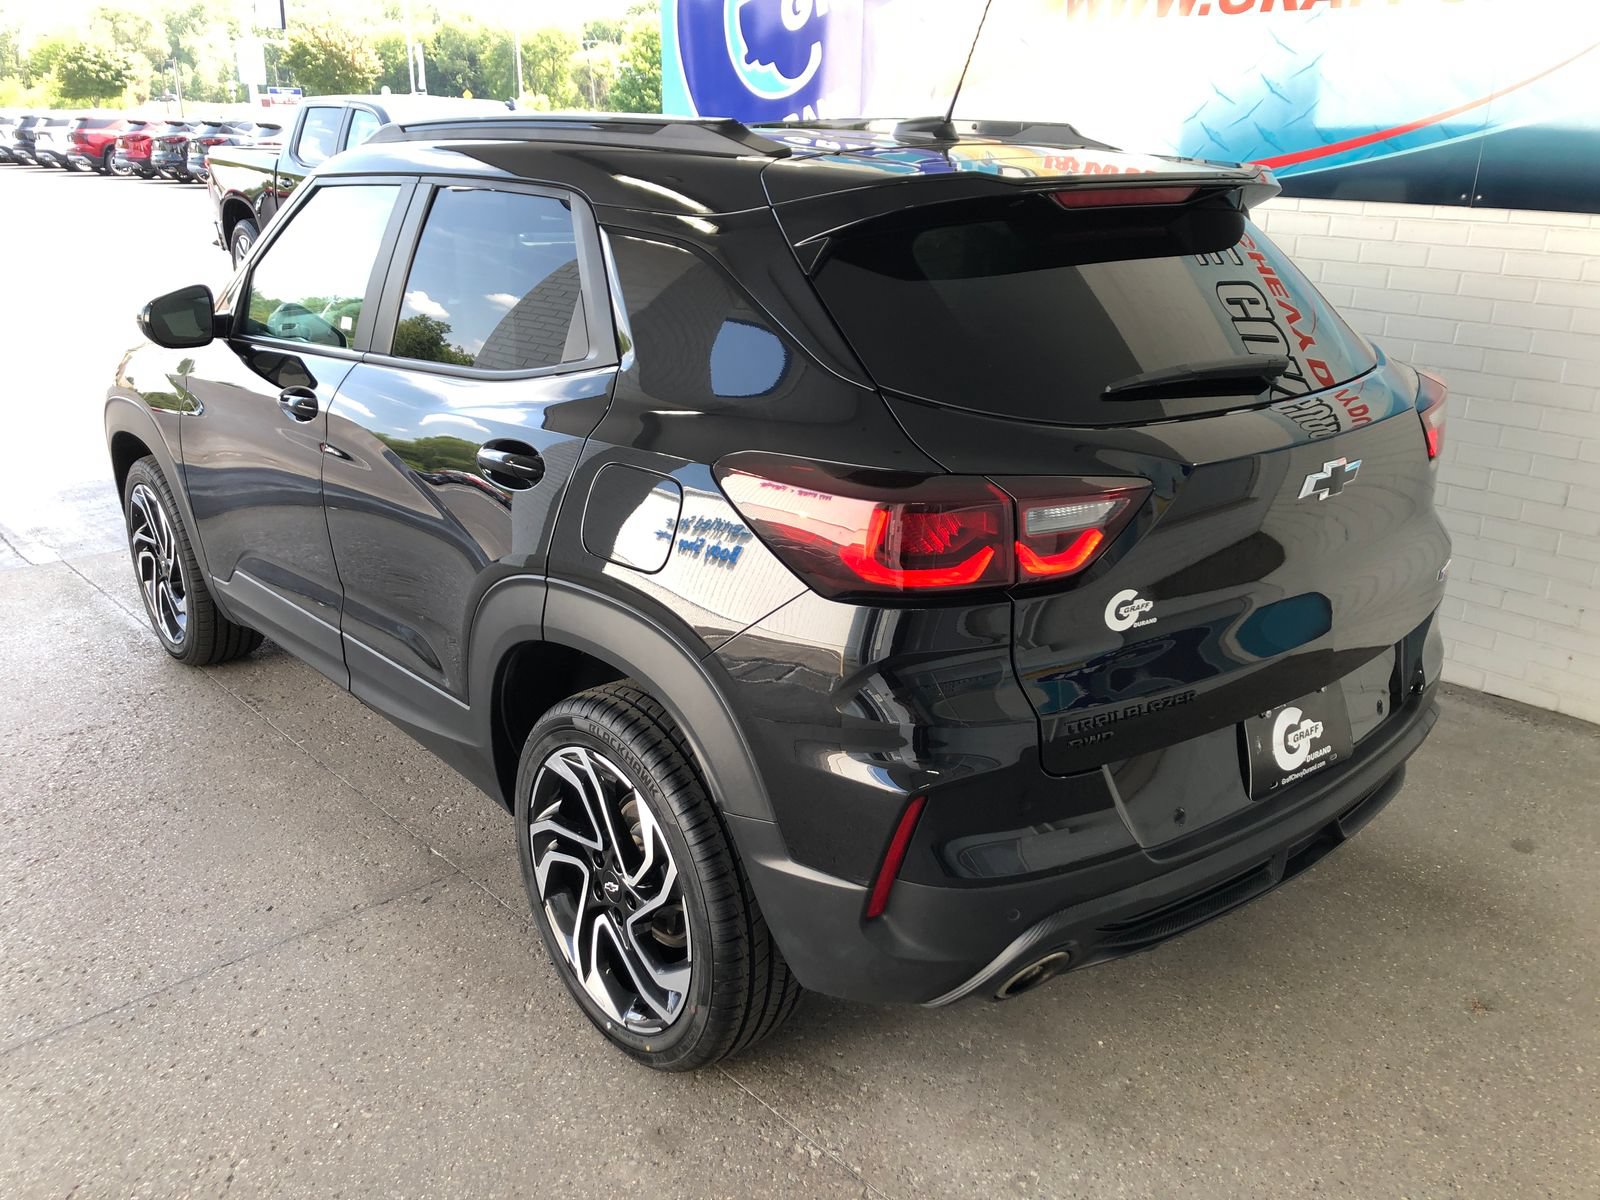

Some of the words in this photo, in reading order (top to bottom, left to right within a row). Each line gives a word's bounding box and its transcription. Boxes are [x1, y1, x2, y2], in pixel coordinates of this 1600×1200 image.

[1123, 602, 1151, 614] GRAFF
[1133, 617, 1157, 628] DURAND
[1064, 689, 1199, 734] TRAILBLAZER
[1293, 724, 1320, 743] GRAFF
[588, 722, 660, 798] BLACKHAWK
[1306, 745, 1332, 763] DURAND
